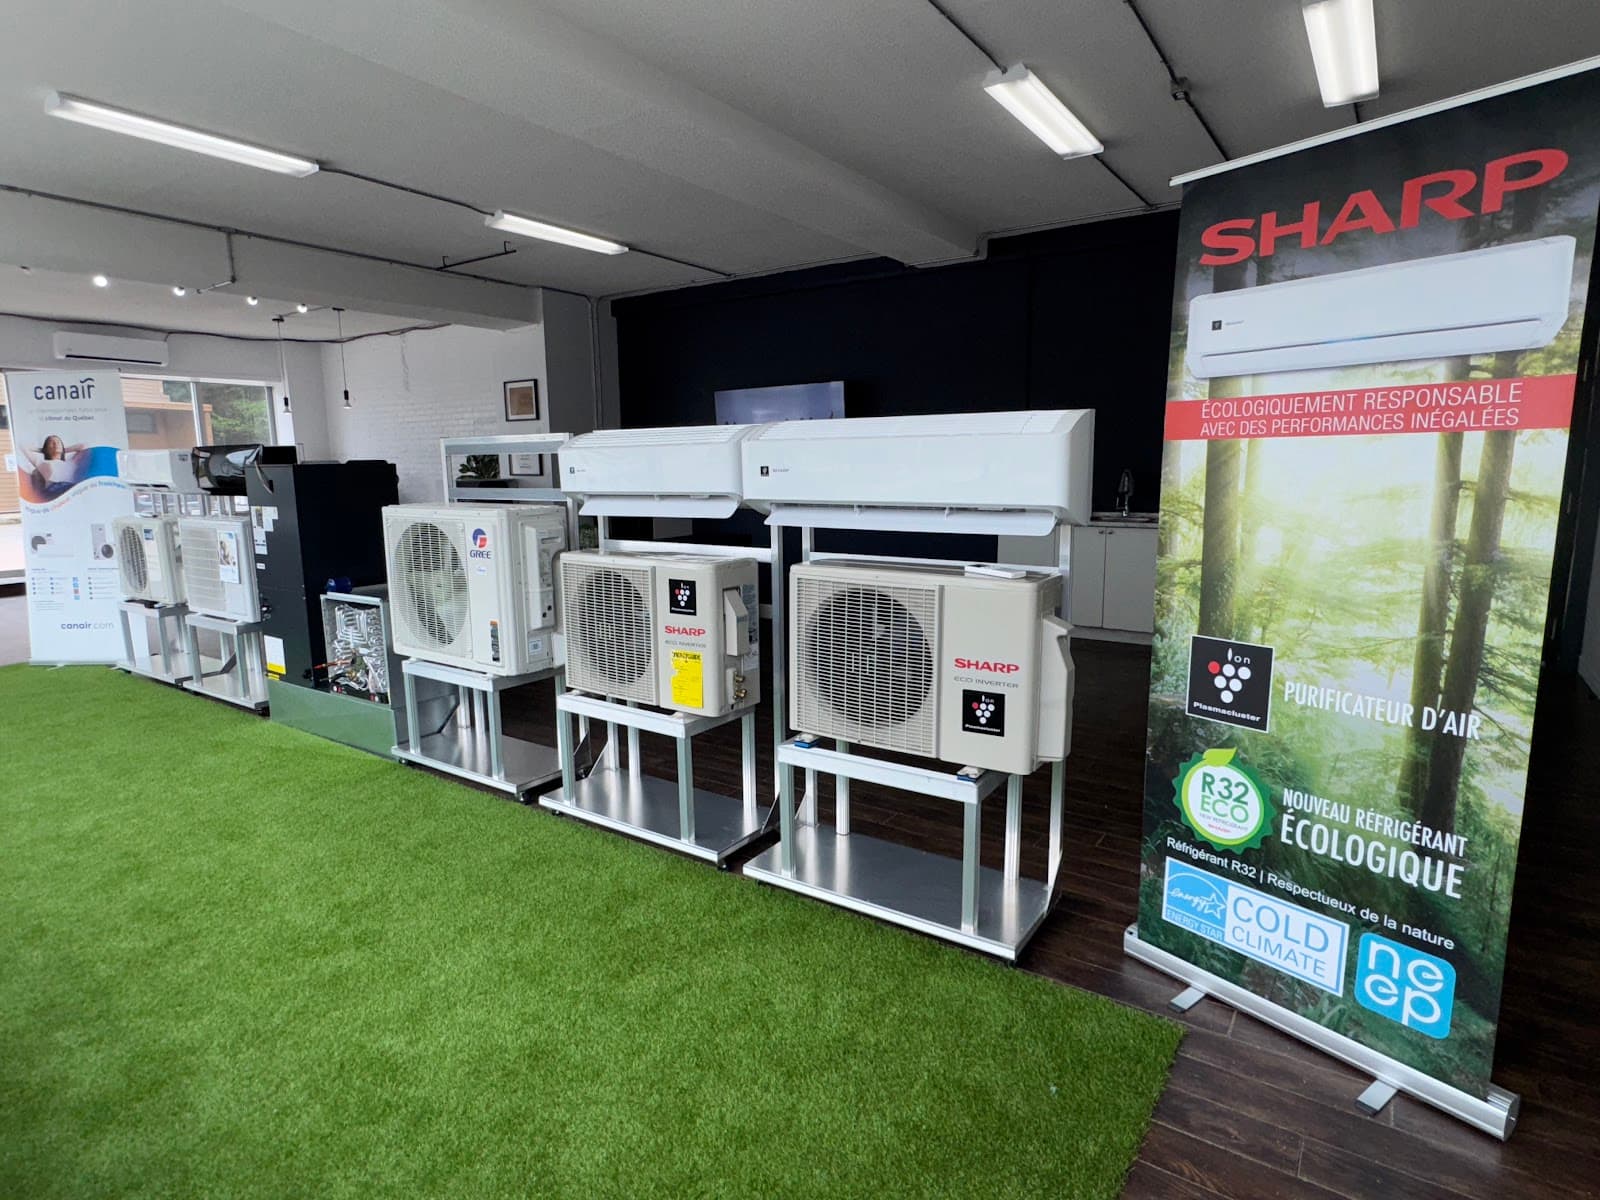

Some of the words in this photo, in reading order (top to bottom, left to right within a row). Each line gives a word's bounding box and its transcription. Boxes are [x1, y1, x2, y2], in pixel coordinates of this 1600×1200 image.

[1200, 149, 1569, 265] SHARP
[1201, 394, 1358, 418] ÉCOLOGIQUEMENT
[1364, 382, 1523, 410] RESPONSABLE
[1200, 420, 1234, 437] AVEC
[1239, 419, 1267, 435] DES
[1271, 413, 1405, 434] PERFORMANCES
[1411, 406, 1520, 429] INÉGALÉES
[469, 549, 492, 559] GREE
[665, 625, 706, 636] SHARP
[954, 658, 1019, 673] SHARP
[1227, 647, 1251, 664] Ion
[976, 680, 1019, 688] INVERTER
[1193, 701, 1261, 722] Plasmacluster
[1284, 680, 1413, 728] PURIFICATEUR
[1422, 706, 1481, 741] D'AIR
[1202, 772, 1249, 806] R32
[1200, 794, 1249, 823] ECO
[1283, 789, 1350, 822] NOUVEAU
[1357, 809, 1467, 856] RÉFRIGÉRANT
[1281, 812, 1466, 899] ÉCOLOGIQUE
[1166, 836, 1229, 868] Réfrigérant
[1231, 858, 1258, 879] R32
[1267, 873, 1357, 917] Respectueux
[1359, 908, 1379, 924] de
[1383, 914, 1397, 928] la
[1401, 920, 1455, 950] nature
[1167, 909, 1199, 931] ENERGY
[1200, 924, 1224, 941] STAR
[1233, 896, 1329, 954] COLD
[1231, 925, 1328, 979] CLIMATE
